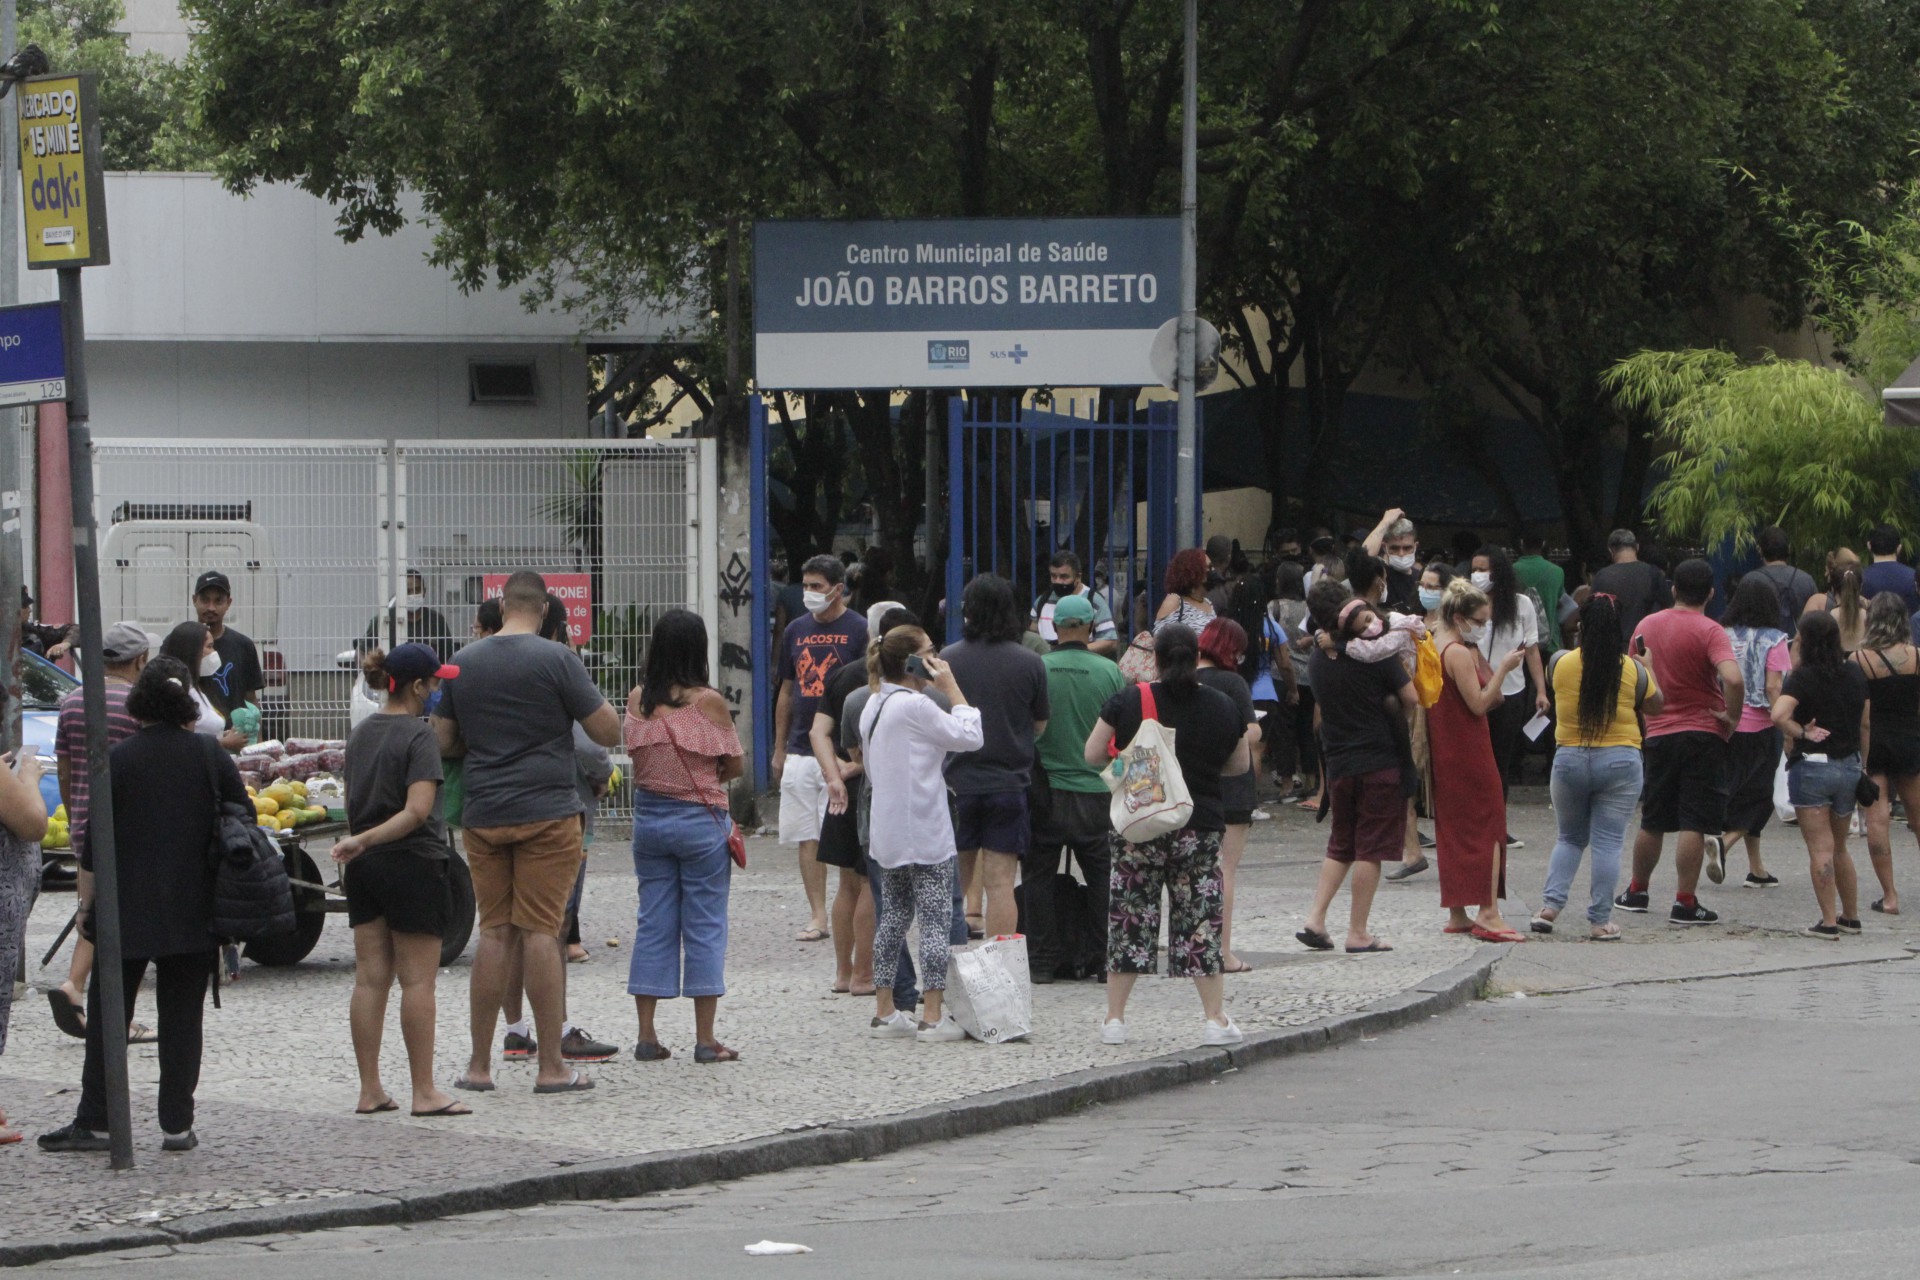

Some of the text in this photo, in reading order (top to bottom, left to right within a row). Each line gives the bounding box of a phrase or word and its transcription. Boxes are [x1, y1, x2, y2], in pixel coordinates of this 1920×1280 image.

[29, 126, 46, 156] 15
[45, 124, 67, 154] MIN
[32, 162, 80, 218] daki
[847, 241, 1108, 267] Centro Municipal de Saúde
[795, 270, 1158, 307] JOÃO BARROS BARRETO
[948, 346, 967, 357] RIO
[989, 350, 1007, 359] SUS
[40, 381, 63, 399] 129
[487, 584, 588, 599] NÃ CIONE!
[573, 605, 587, 617] de
[796, 634, 849, 646] LACOSTE
